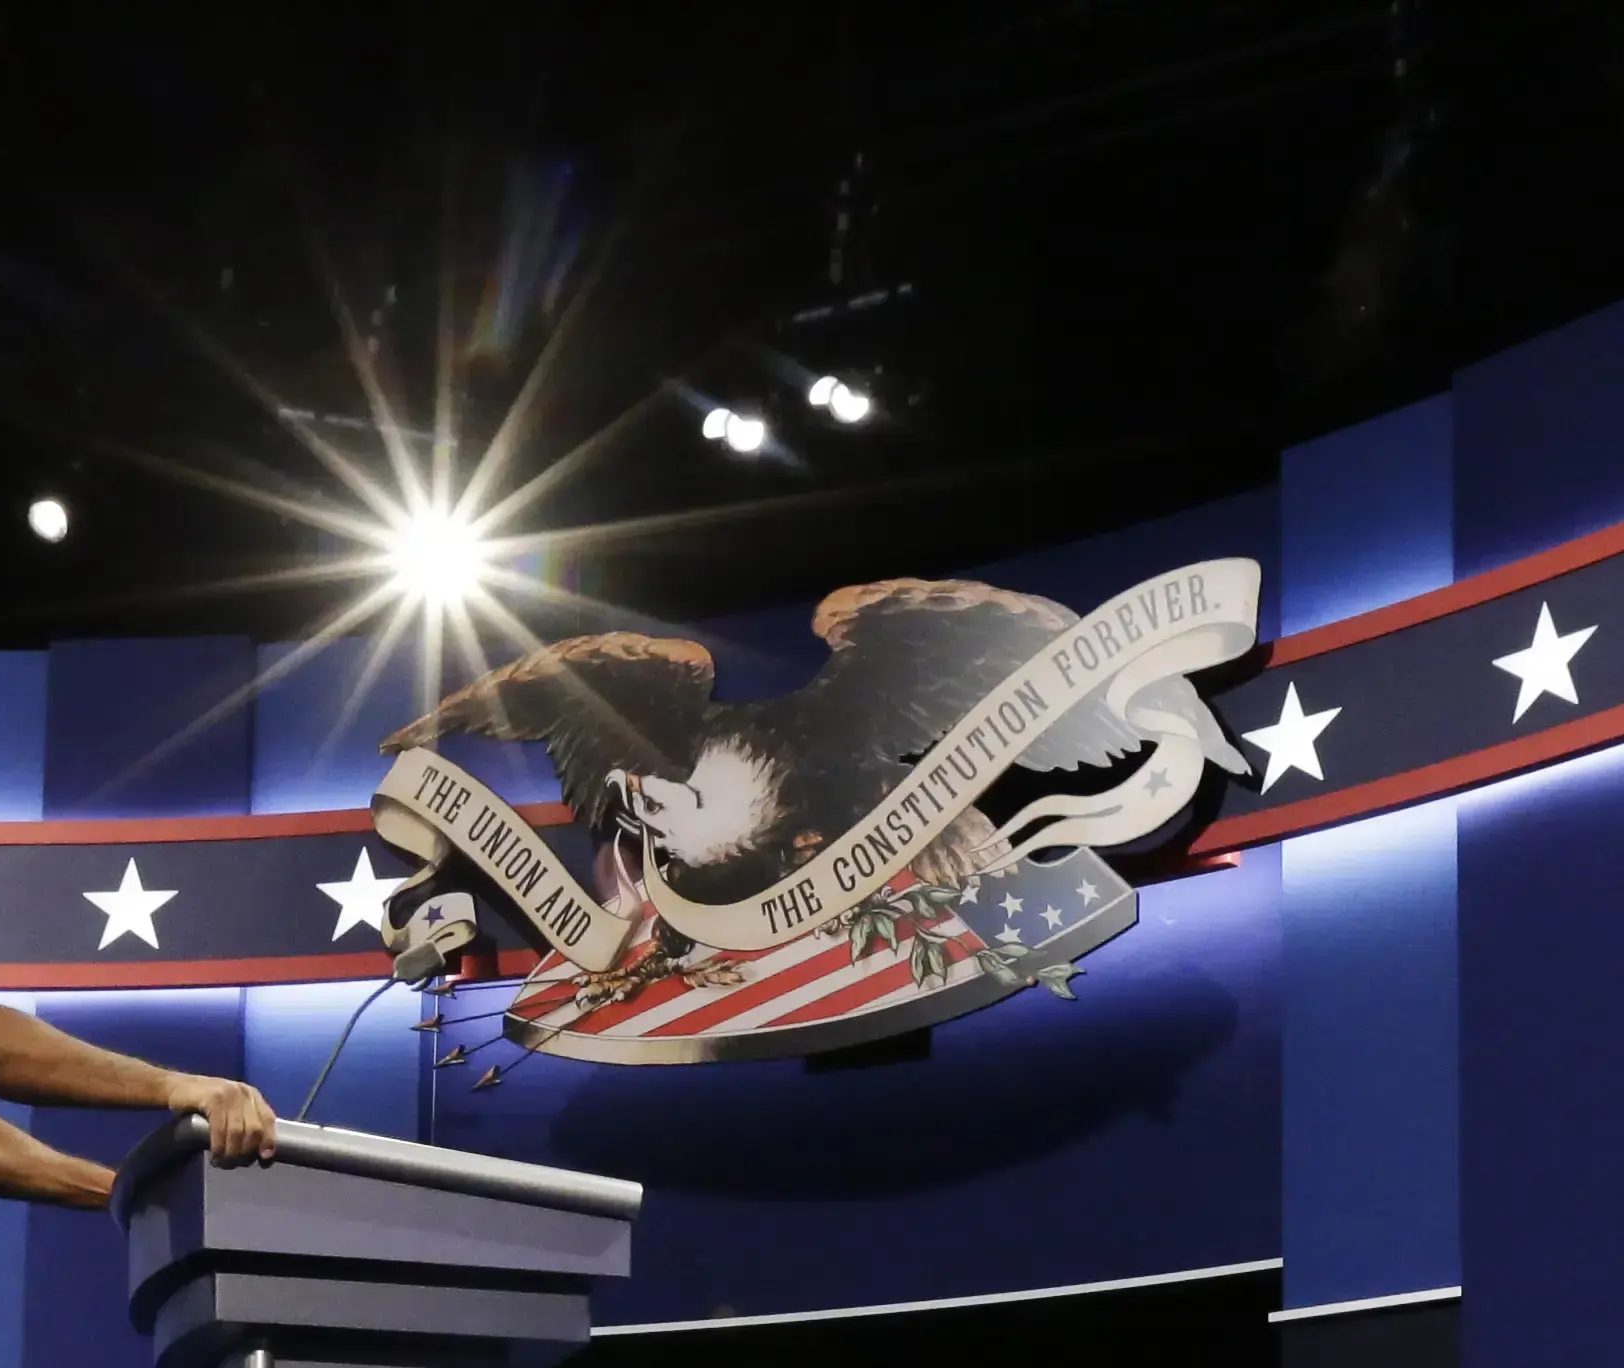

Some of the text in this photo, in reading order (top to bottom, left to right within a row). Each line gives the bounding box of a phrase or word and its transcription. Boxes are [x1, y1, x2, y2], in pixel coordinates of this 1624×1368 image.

[413, 765, 592, 947] THE UNION AND
[761, 573, 1222, 934] THE CONSTITUTION FOREVER.
